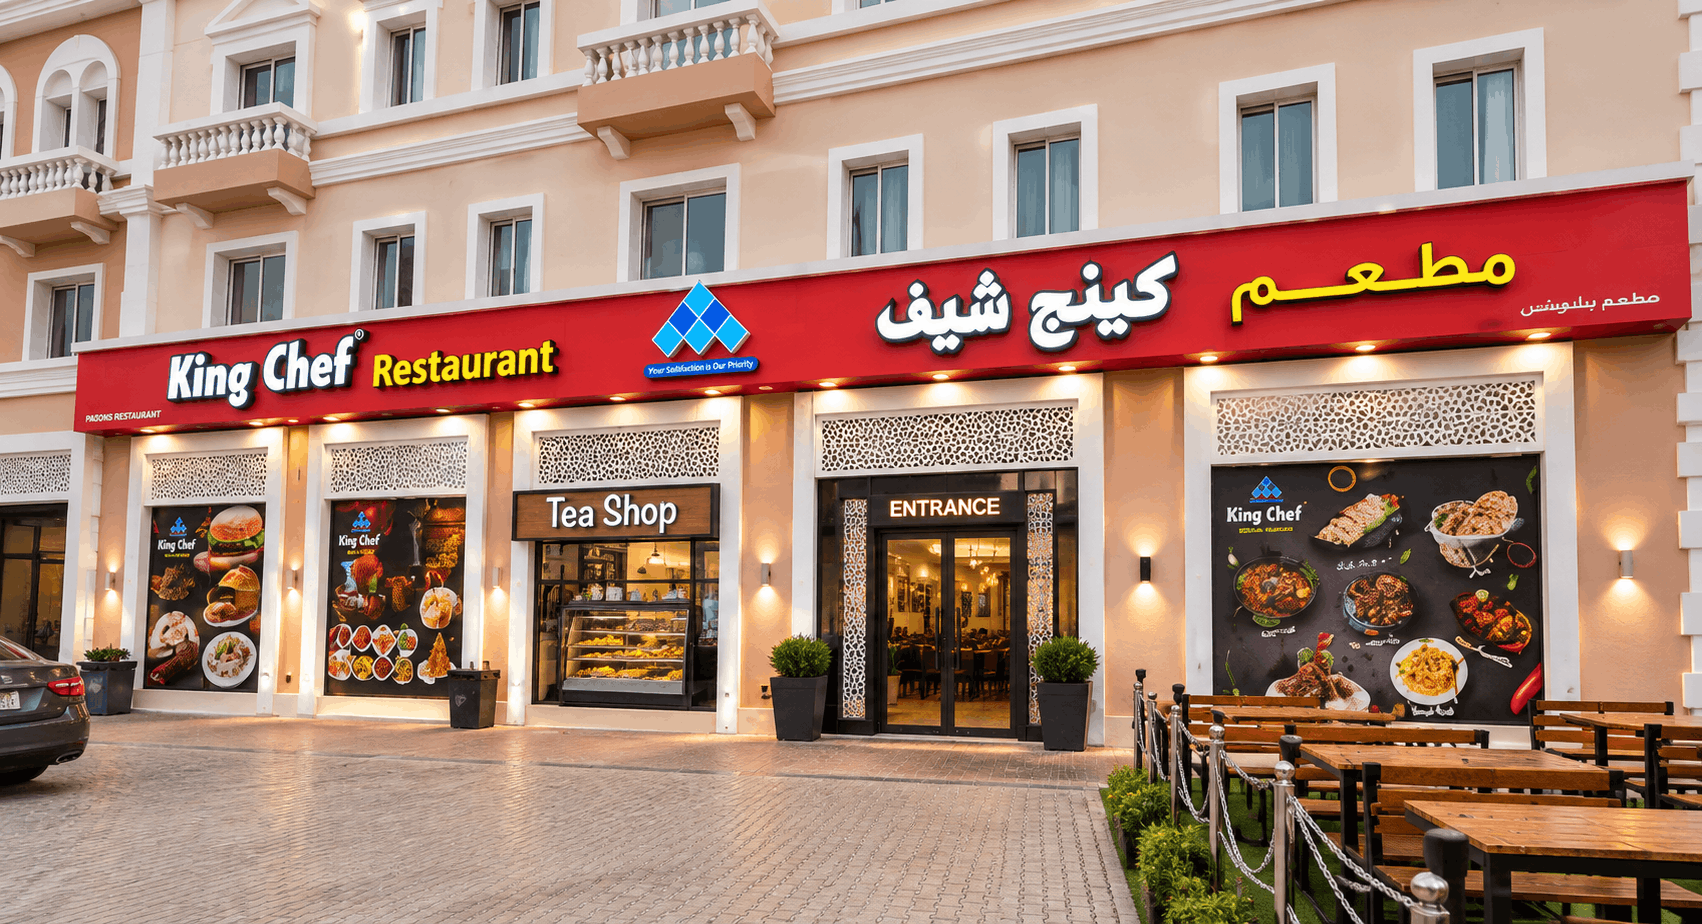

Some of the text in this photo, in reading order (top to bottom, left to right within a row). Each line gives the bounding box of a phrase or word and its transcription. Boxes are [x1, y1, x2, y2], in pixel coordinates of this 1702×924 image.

[875, 242, 1516, 354] مطعم كينج شيف
[167, 353, 256, 408] King
[372, 340, 556, 388] Restaurant
[712, 362, 726, 370] Our
[546, 493, 678, 534] Tea Shop
[890, 497, 1001, 517] ENTRANCE
[1226, 504, 1302, 526] King Chef
[157, 538, 197, 553] King Chef
[338, 533, 381, 549] King Chef
